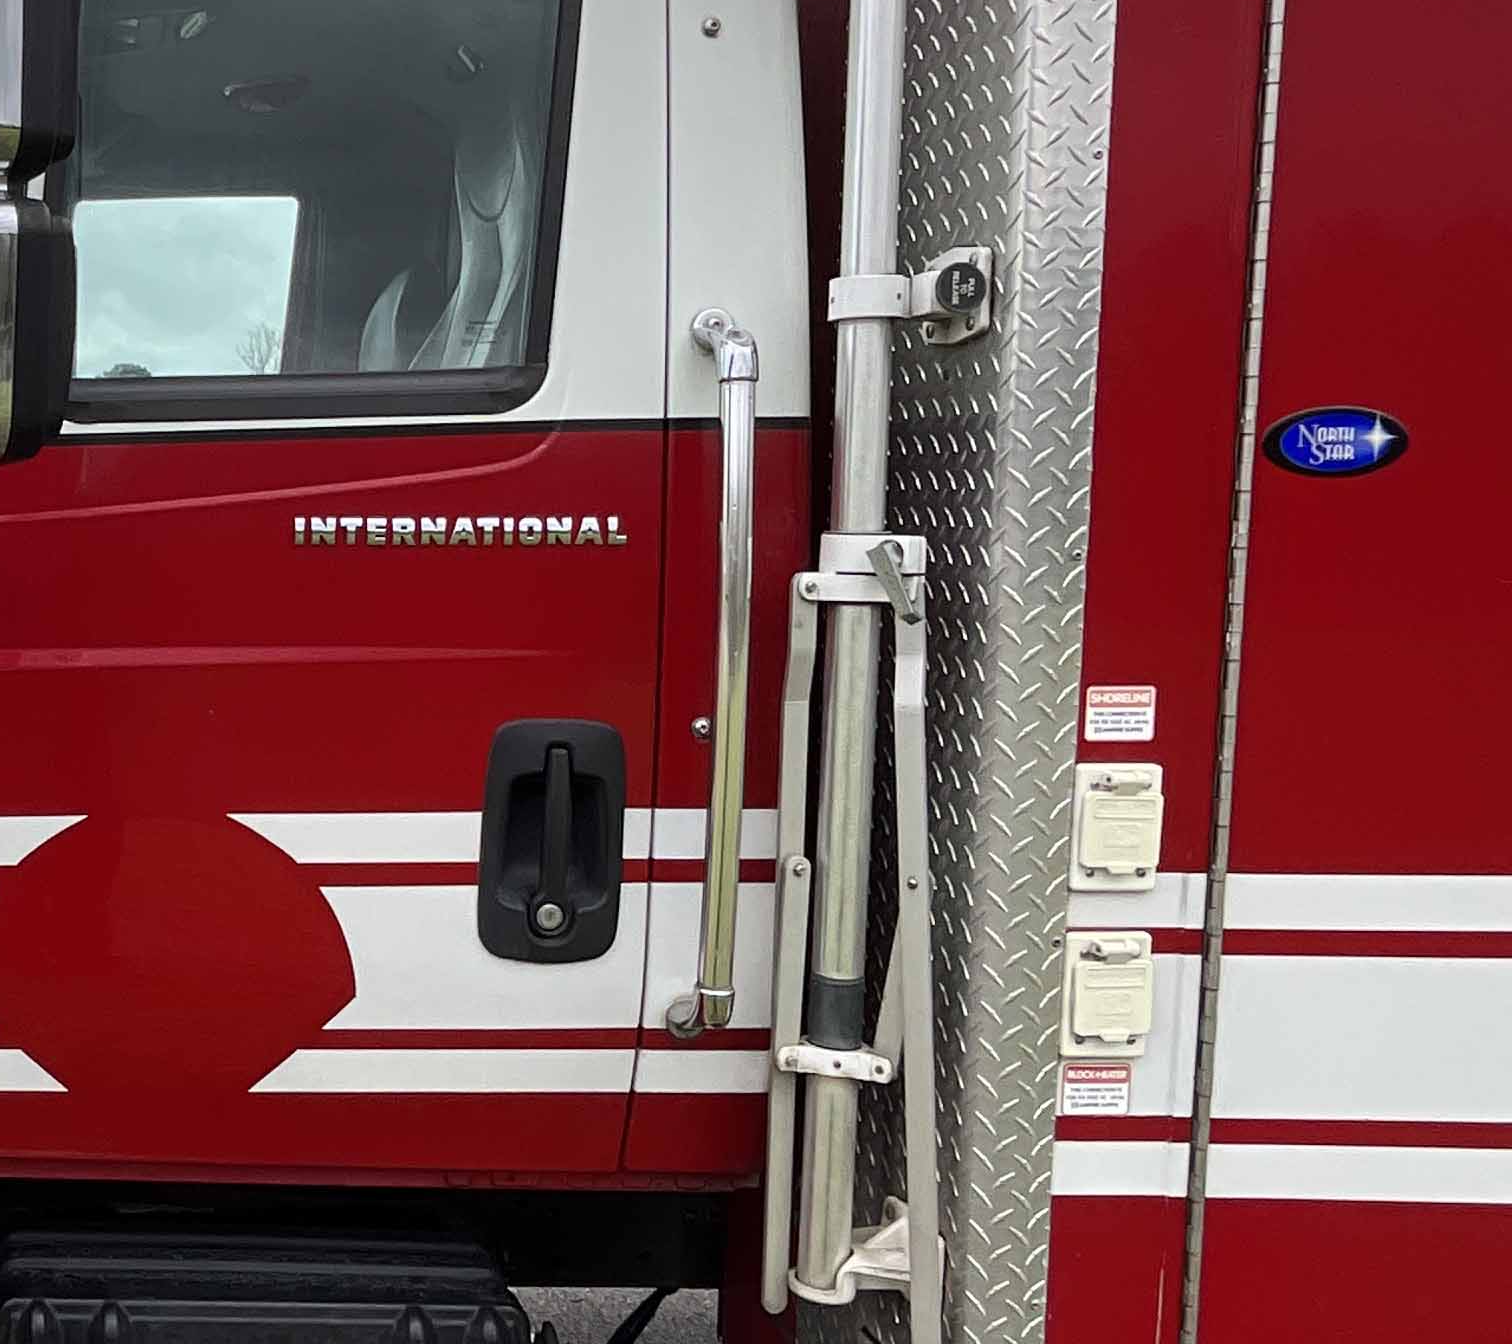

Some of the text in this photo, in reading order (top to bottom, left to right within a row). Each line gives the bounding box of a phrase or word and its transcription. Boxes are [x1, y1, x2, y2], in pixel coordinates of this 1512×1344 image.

[1296, 424, 1356, 448] NORTH
[1309, 443, 1355, 465] STAR
[293, 516, 628, 546] INTERNATIONAL
[1090, 692, 1151, 704] SHORELINE
